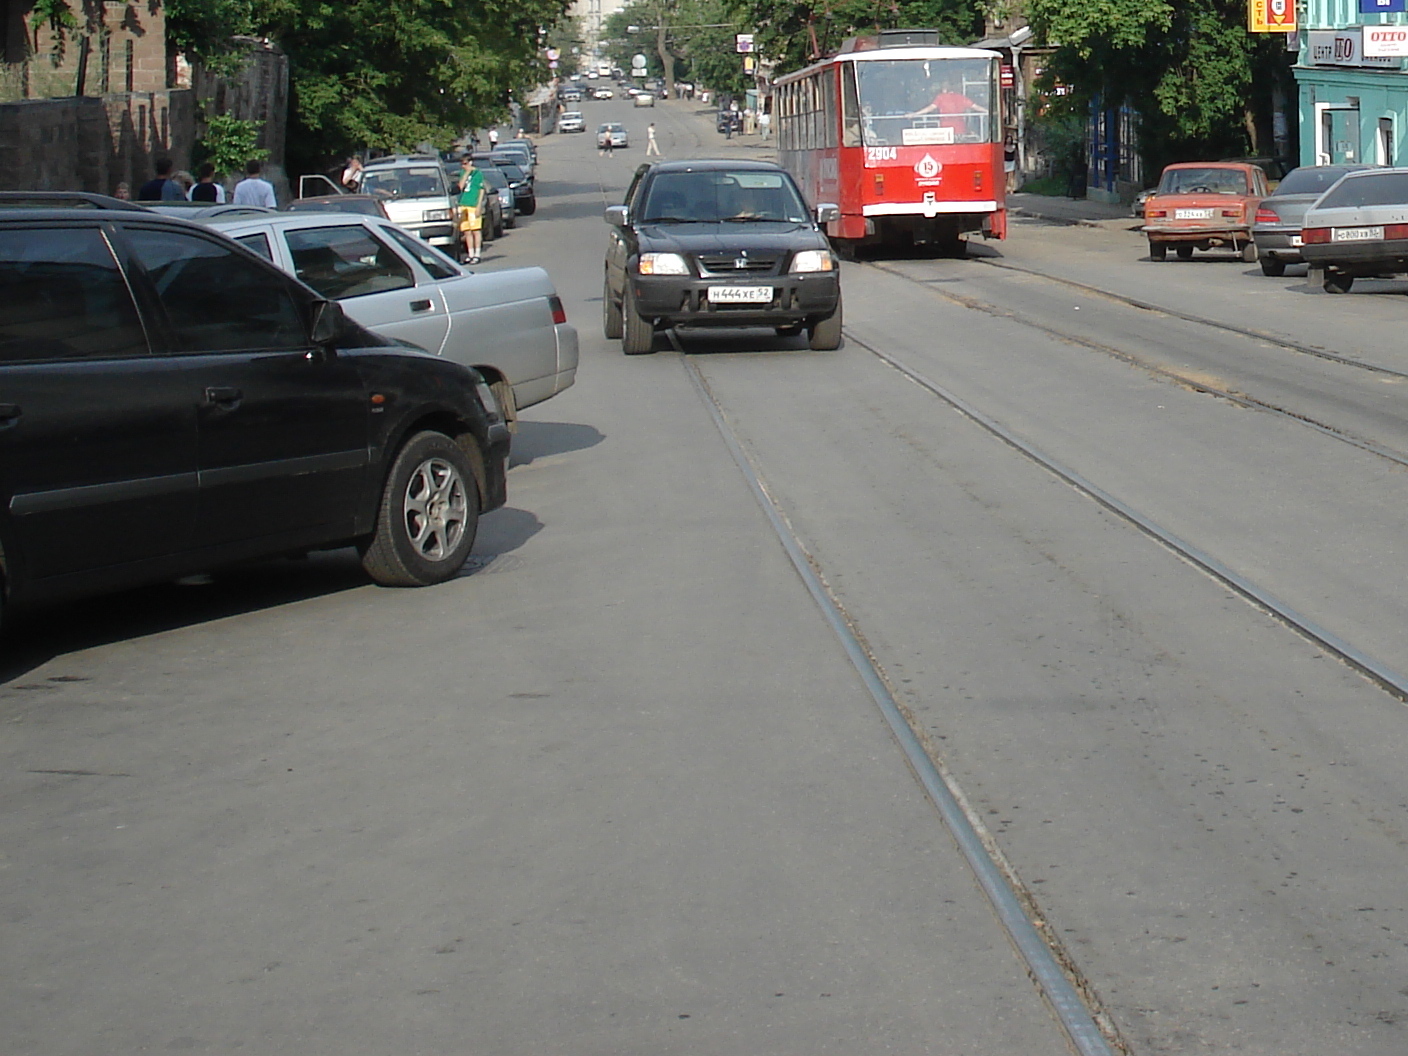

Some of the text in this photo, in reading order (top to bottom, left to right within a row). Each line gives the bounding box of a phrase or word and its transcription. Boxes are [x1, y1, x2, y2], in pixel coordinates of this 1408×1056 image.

[1370, 31, 1407, 42] OTTO
[867, 146, 897, 161] 2904
[923, 161, 934, 171] 15
[713, 288, 755, 299] Н444ХЕ
